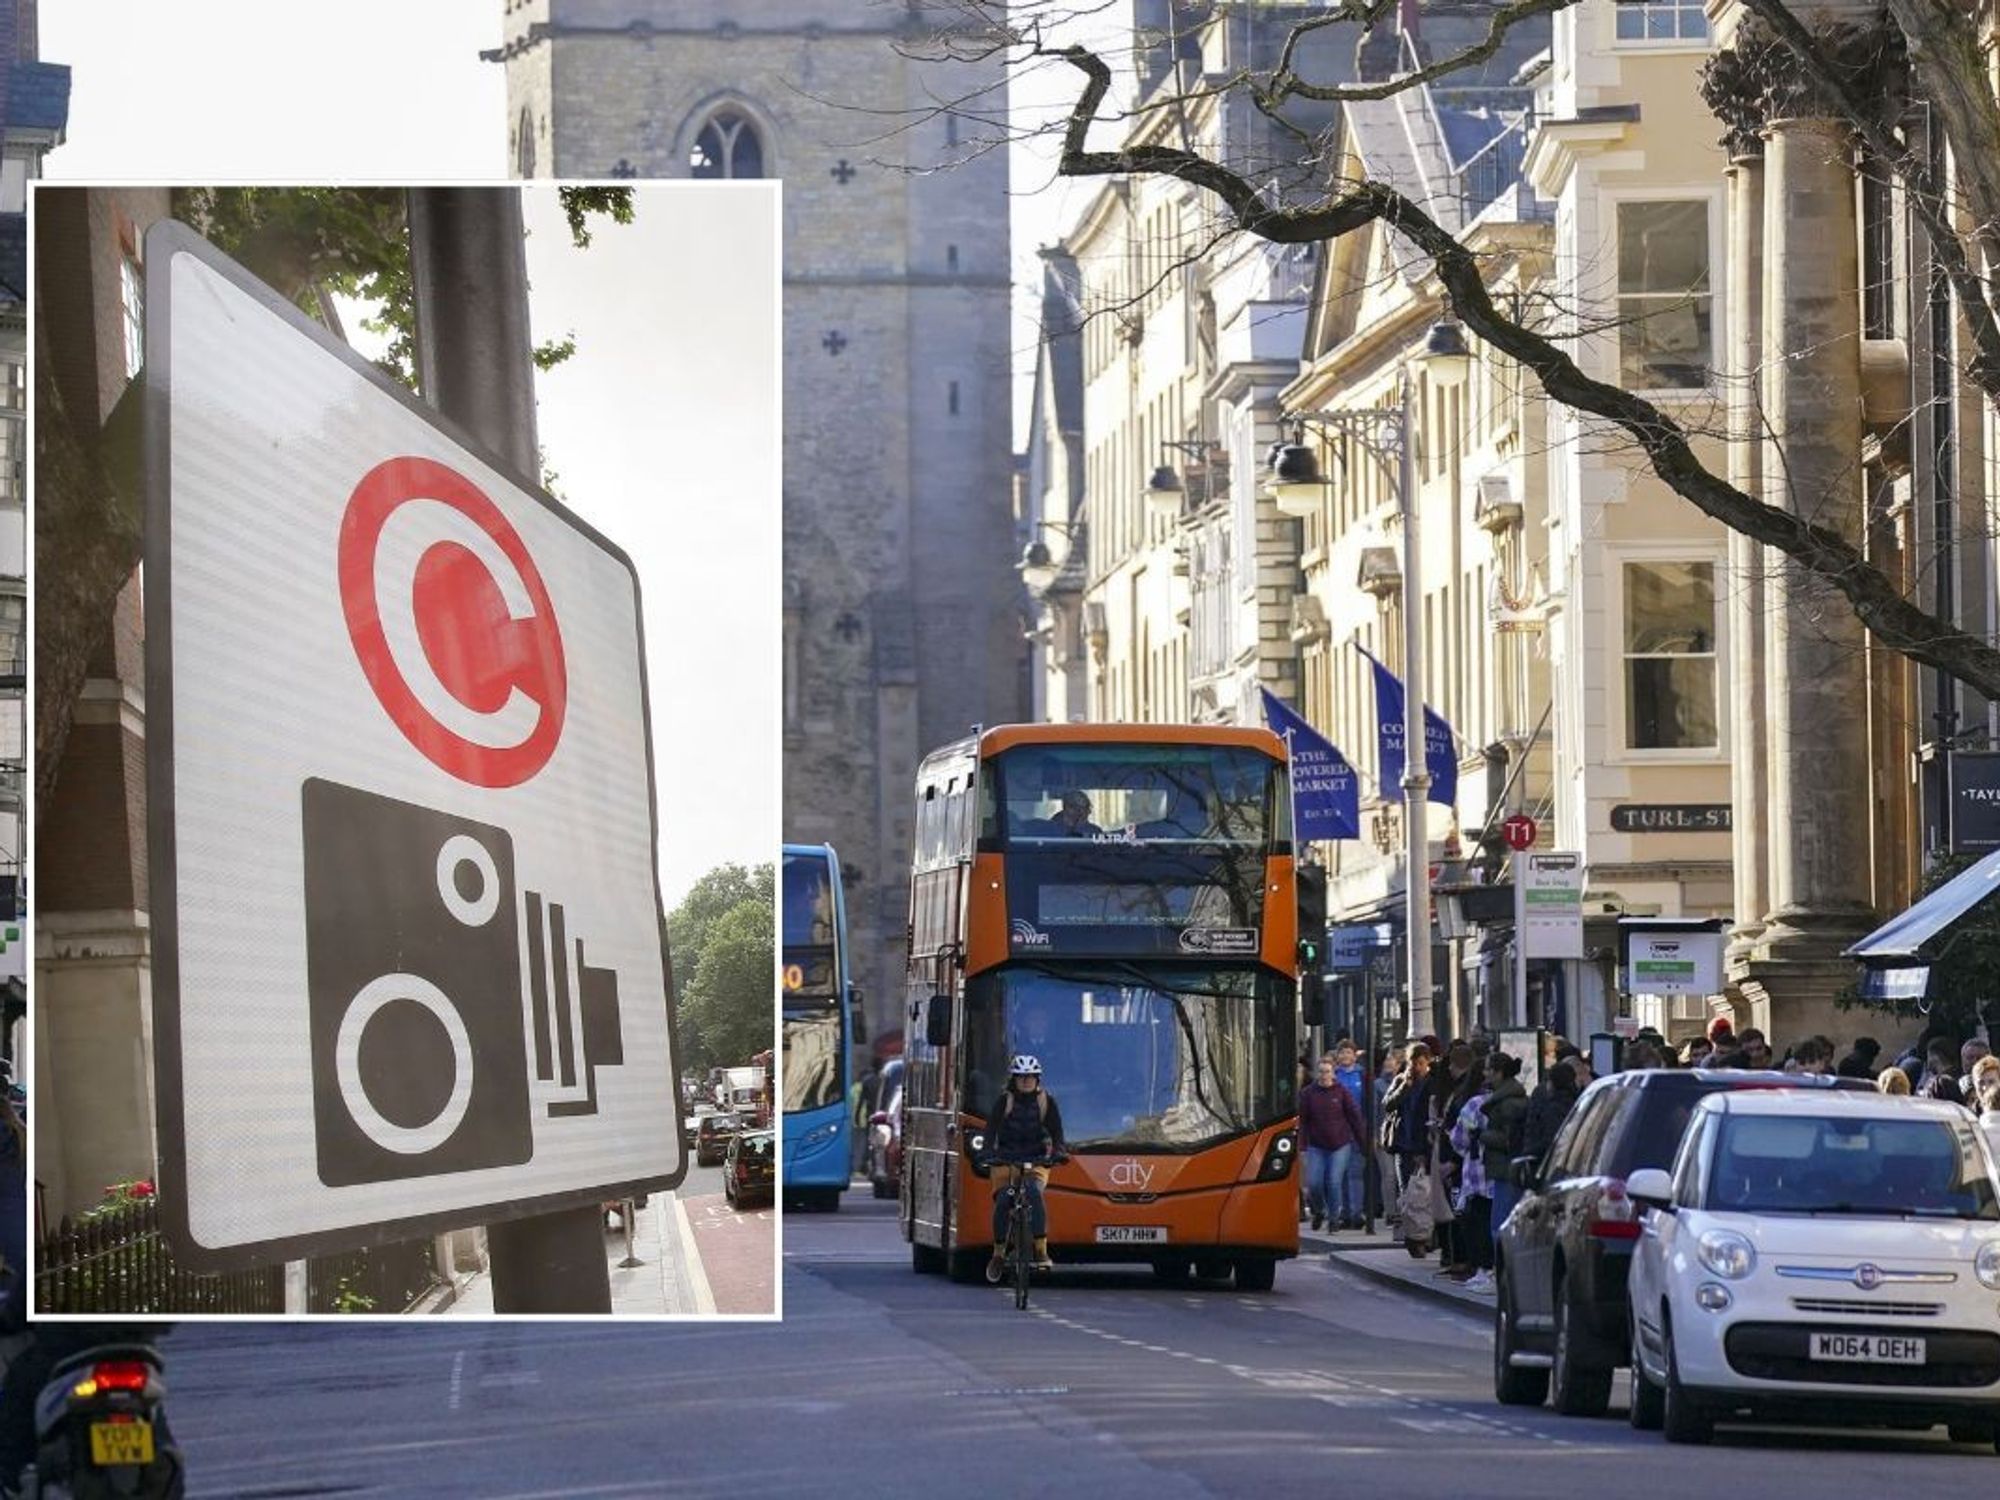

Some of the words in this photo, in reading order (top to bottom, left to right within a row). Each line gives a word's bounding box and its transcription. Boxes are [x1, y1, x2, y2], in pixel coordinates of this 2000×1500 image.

[374, 498, 541, 748] C
[1381, 723, 1449, 741] COED
[1297, 751, 1329, 762] THE
[1292, 764, 1349, 777] OVERED
[1506, 822, 1531, 841] T1
[1109, 1158, 1154, 1190] city
[1101, 1227, 1129, 1241] SK17
[1132, 1227, 1157, 1240] HHW
[1818, 1334, 1870, 1357] WO64
[1877, 1337, 1918, 1359] OEH
